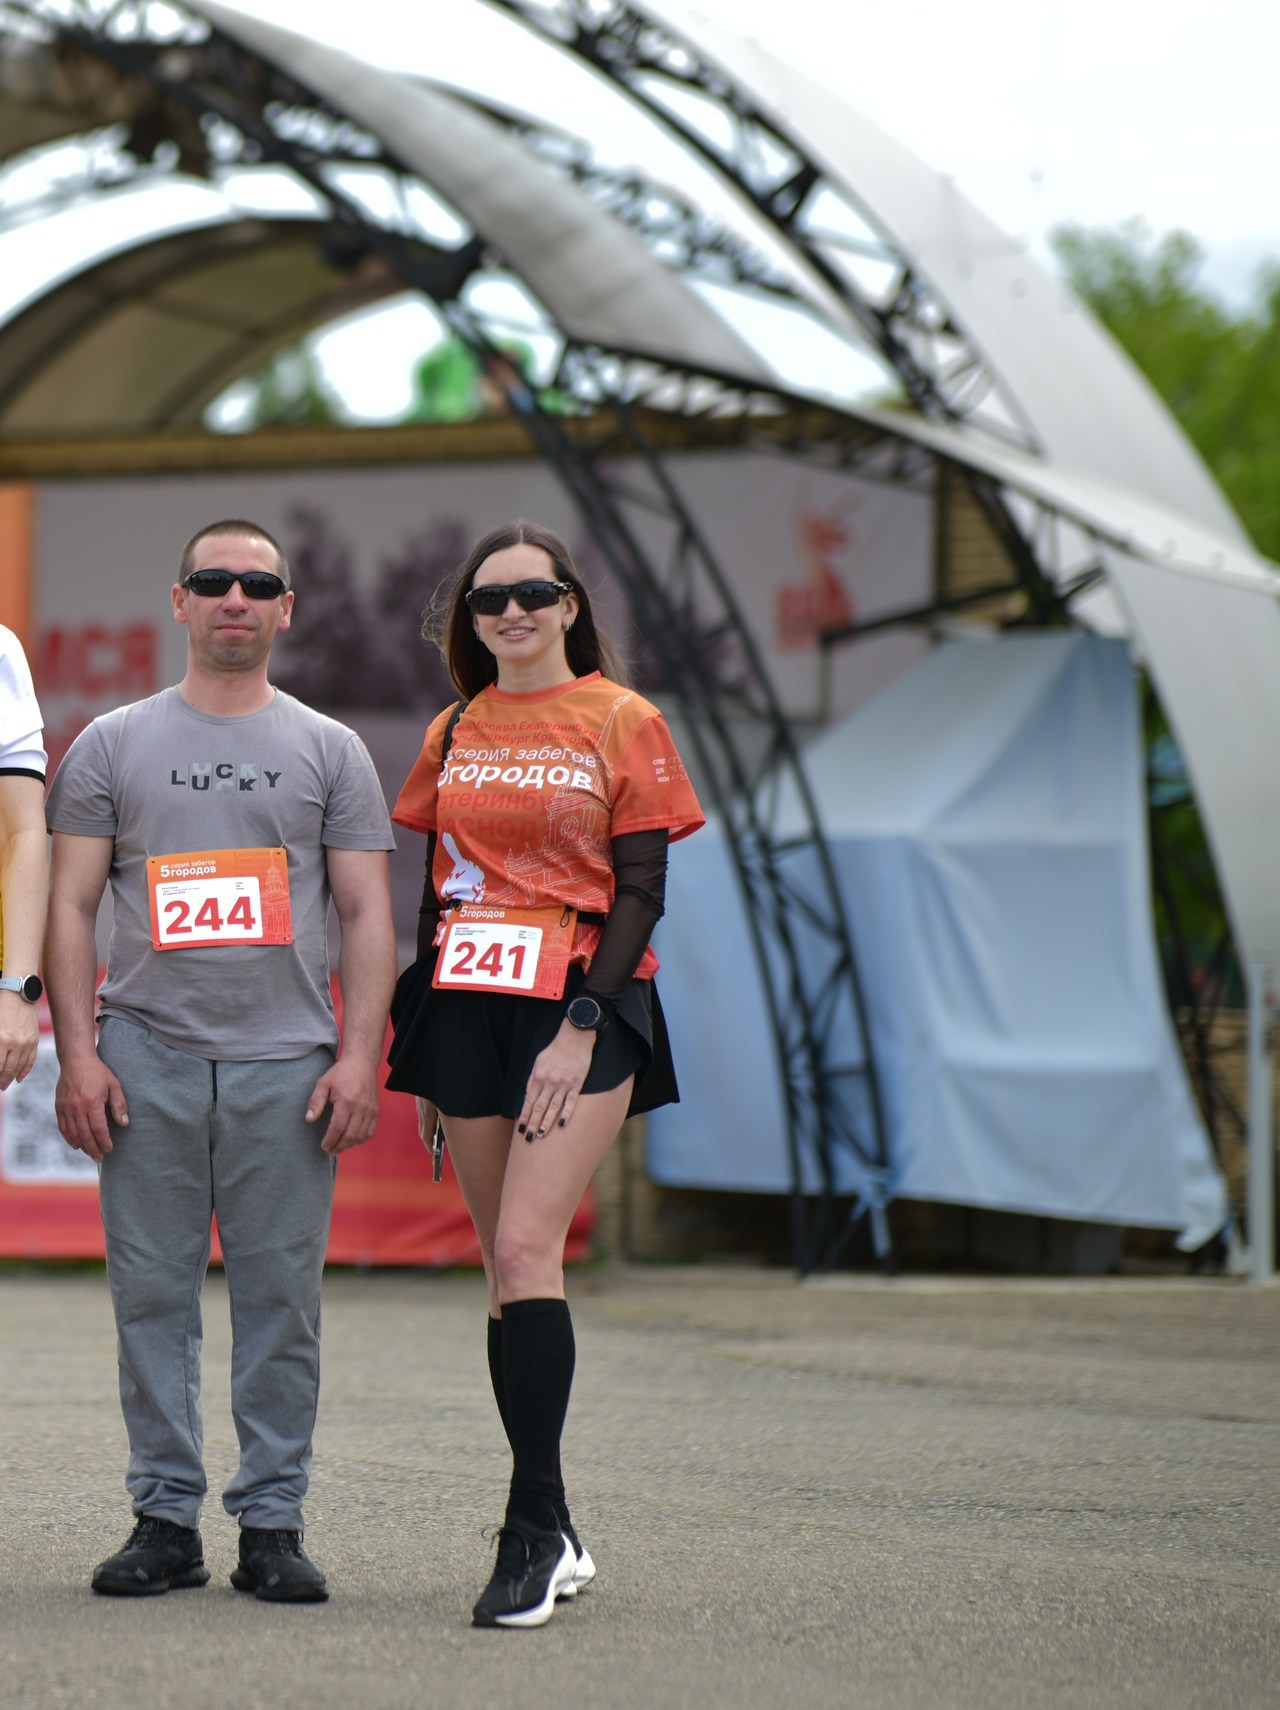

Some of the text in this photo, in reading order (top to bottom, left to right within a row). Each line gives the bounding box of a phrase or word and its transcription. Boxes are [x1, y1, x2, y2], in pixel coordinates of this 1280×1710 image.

[472, 721, 516, 732] Москва
[455, 748, 511, 762] серия
[516, 745, 597, 768] забегов
[170, 763, 282, 791] LUCKY
[170, 866, 217, 877] городов
[164, 896, 256, 935] 244
[467, 909, 506, 919] городов
[450, 941, 526, 980] 241
